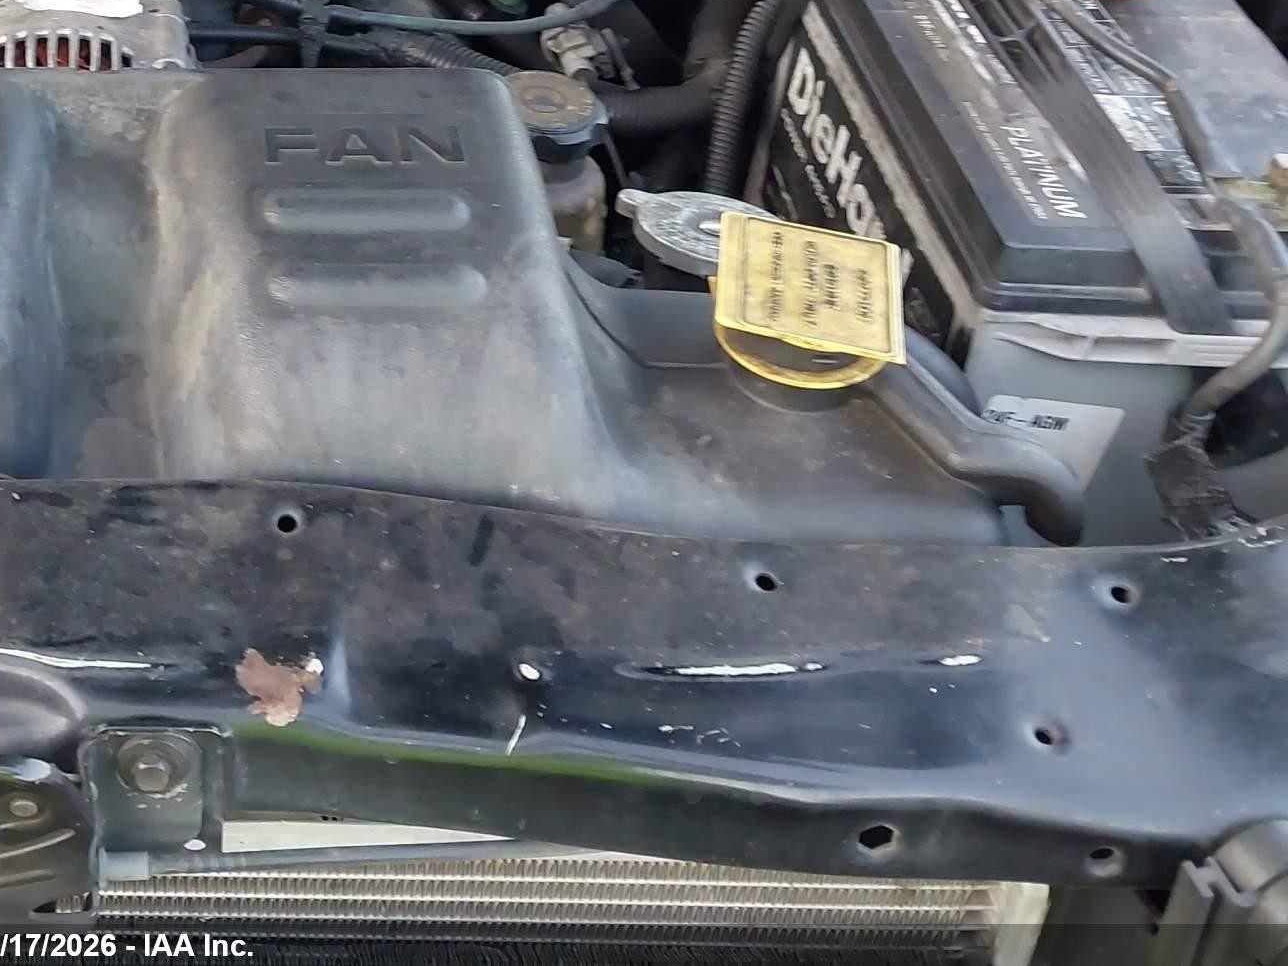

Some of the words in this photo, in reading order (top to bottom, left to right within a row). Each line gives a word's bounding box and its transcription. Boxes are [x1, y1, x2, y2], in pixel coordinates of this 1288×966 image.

[264, 126, 466, 166] FAN
[787, 46, 912, 286] DieHa
[999, 125, 1089, 219] PLATINUM
